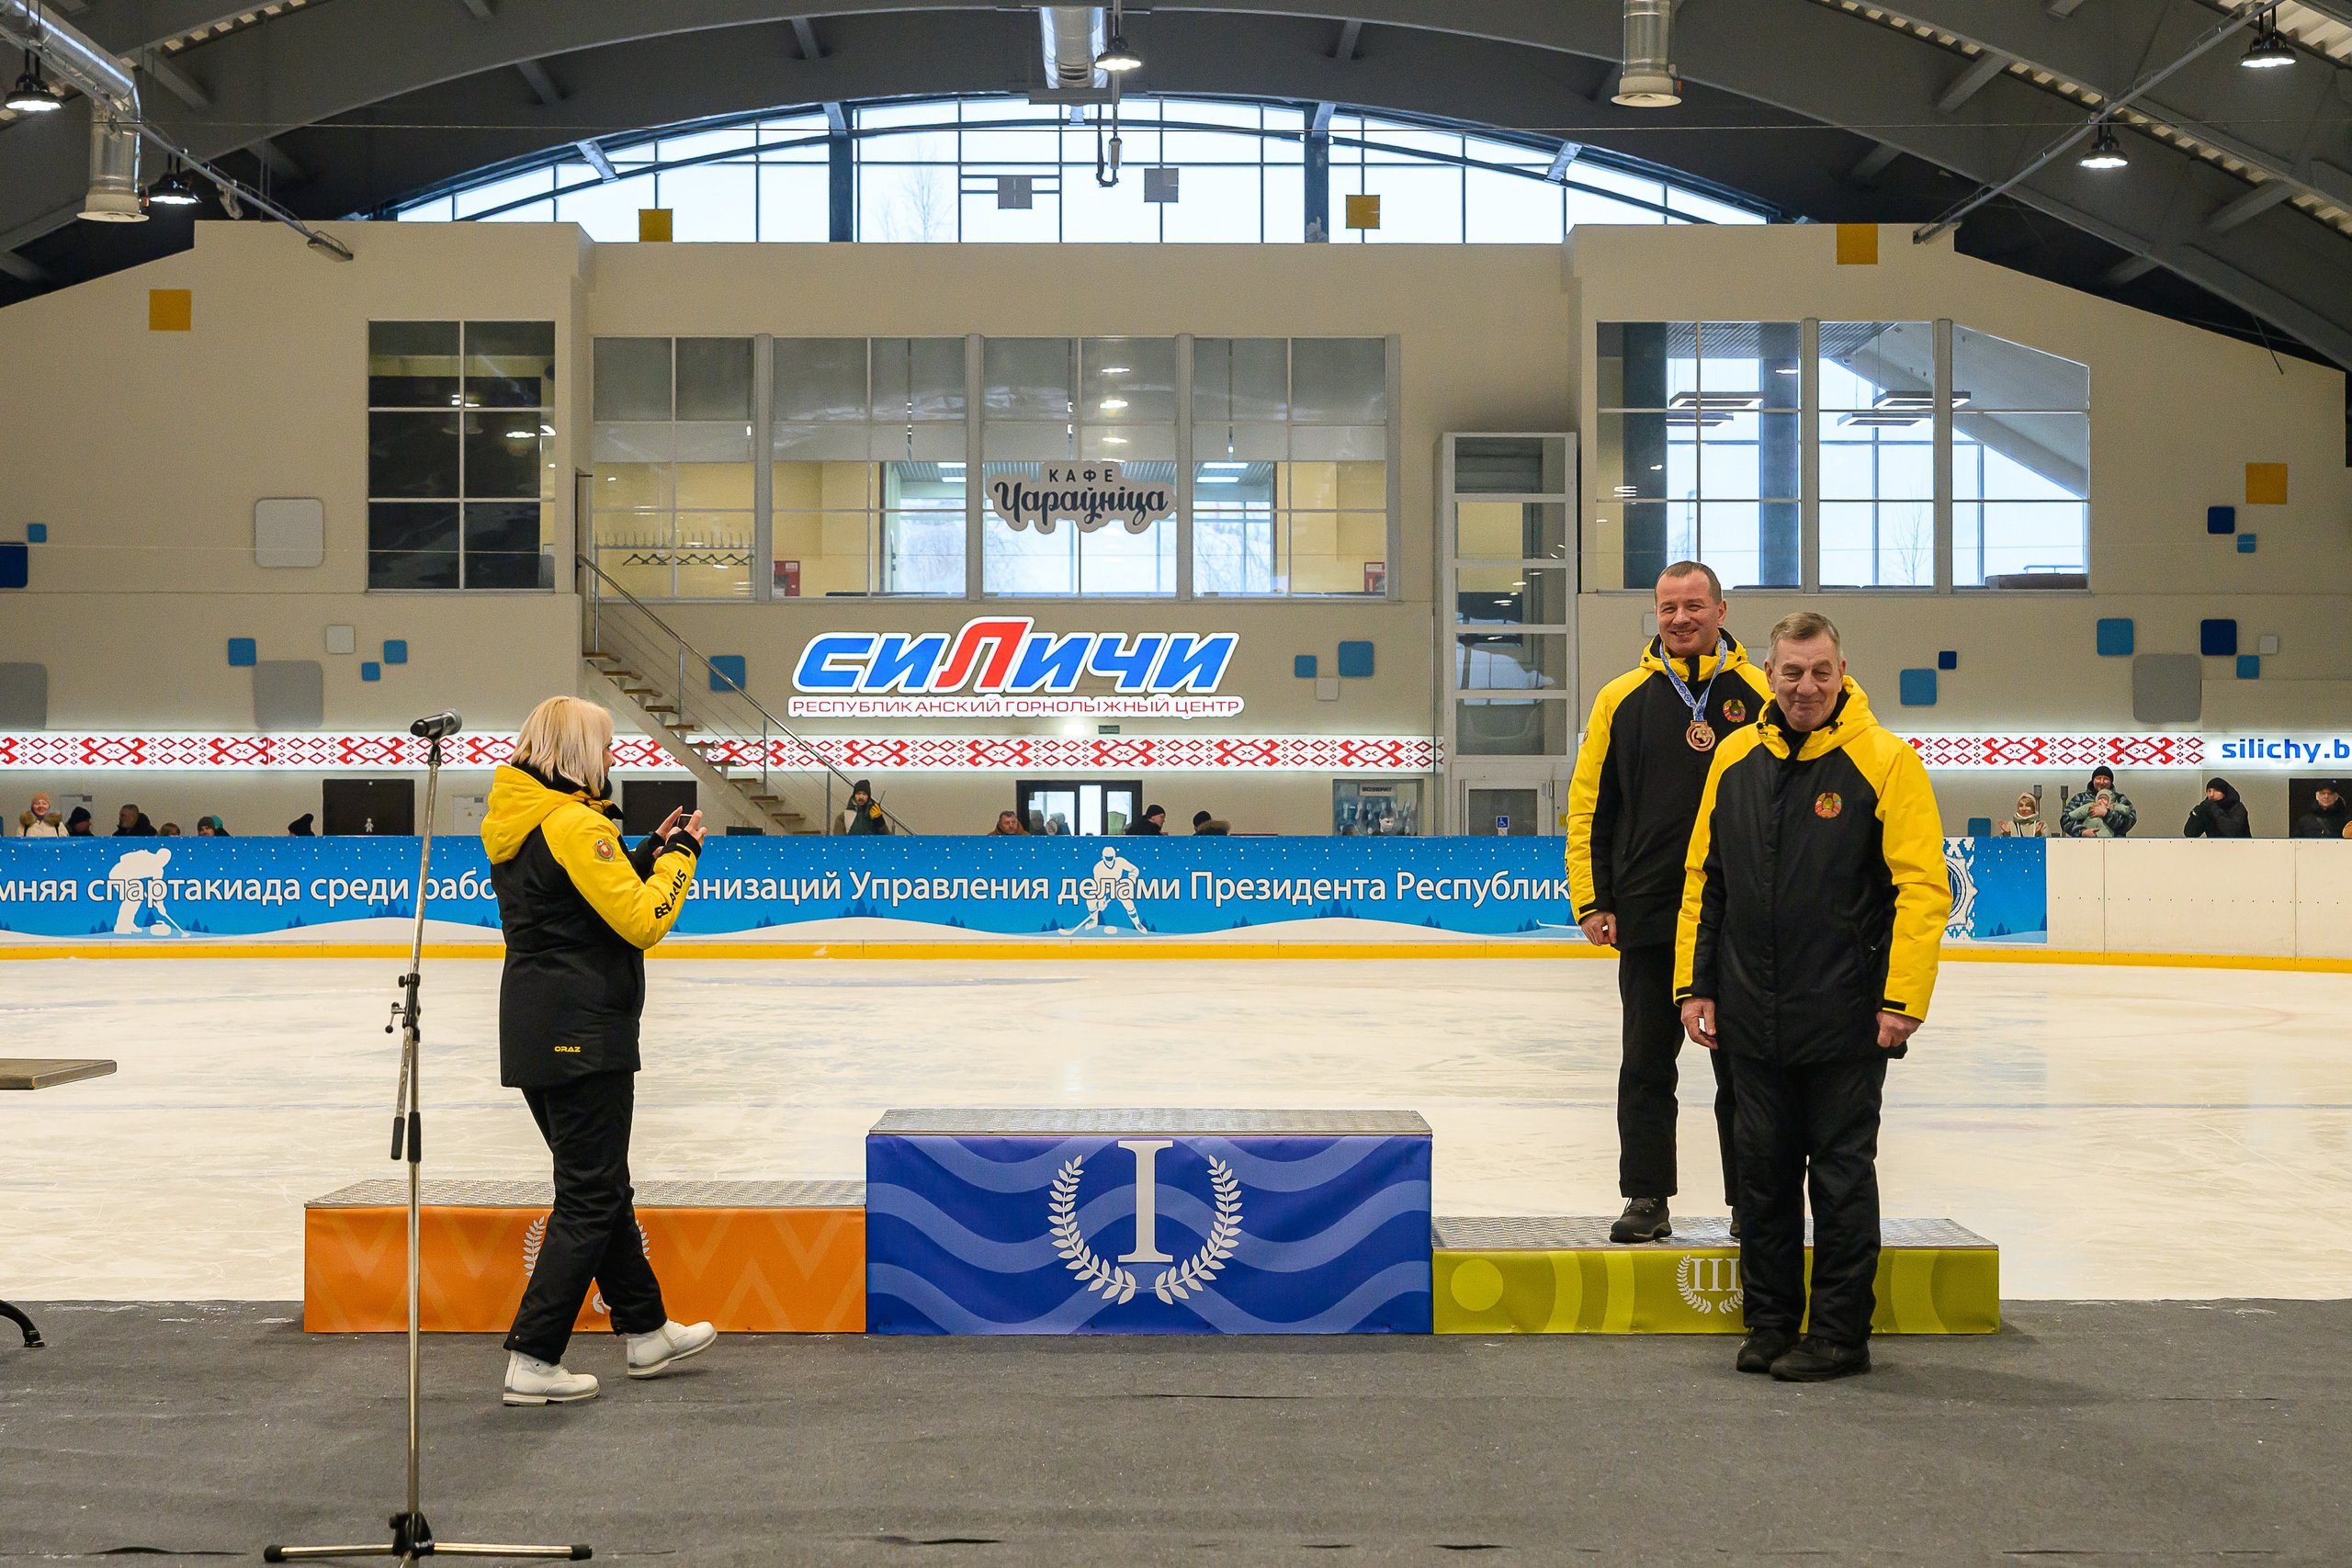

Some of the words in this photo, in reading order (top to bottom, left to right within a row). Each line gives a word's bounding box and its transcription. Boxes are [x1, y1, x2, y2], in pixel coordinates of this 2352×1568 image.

[1049, 468, 1114, 482] КАФЕ
[994, 481, 1169, 526] Чараўніца
[793, 698, 1001, 713] РЕСПУБЛИКАНСКИЙ
[1005, 698, 1170, 713] ГОРНОЛЫЖНЫЙ
[1176, 701, 1239, 714] ЦЕНТР
[2222, 739, 2350, 763] silichy.b
[0, 879, 77, 901] мняя
[87, 879, 300, 908] спартакиада
[311, 879, 409, 908] среди
[685, 871, 842, 905] анизаций
[850, 872, 1049, 908] Управления
[1057, 878, 1181, 905] делами
[1191, 871, 1387, 908] Президента
[1396, 870, 1571, 908] Республик
